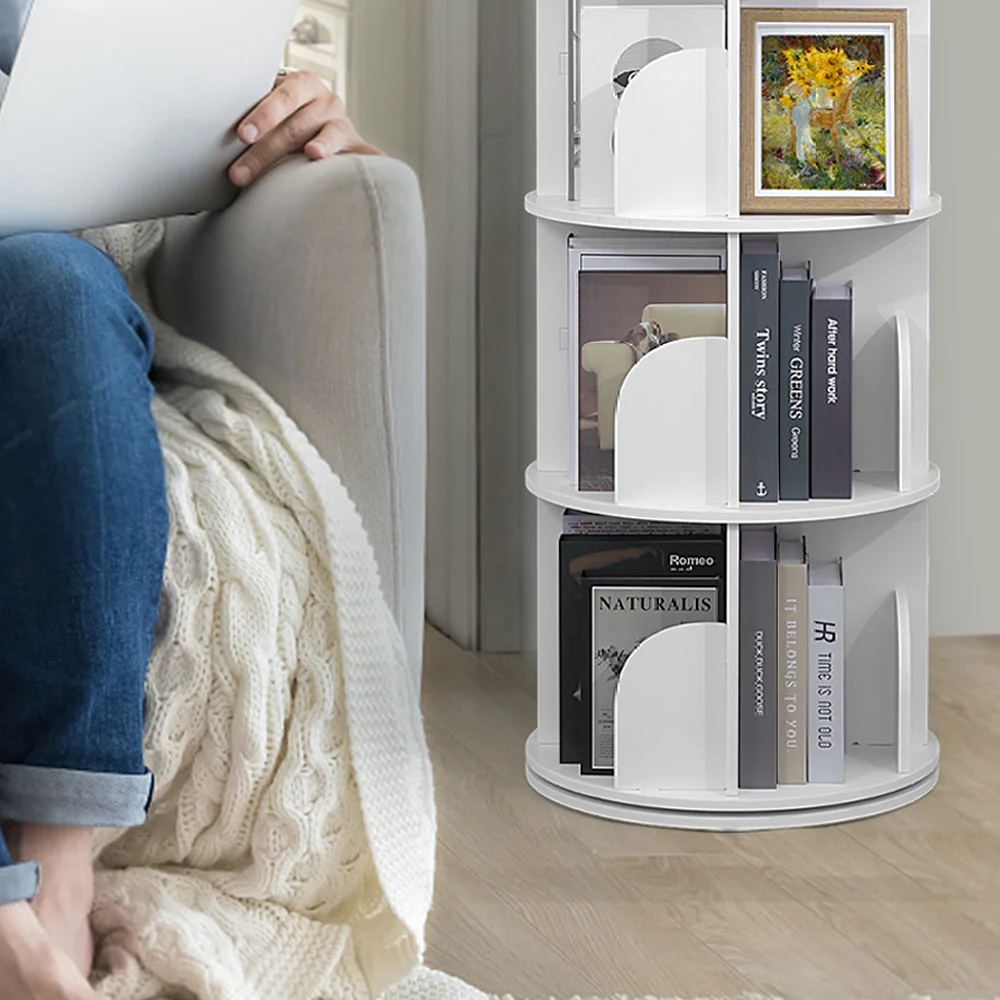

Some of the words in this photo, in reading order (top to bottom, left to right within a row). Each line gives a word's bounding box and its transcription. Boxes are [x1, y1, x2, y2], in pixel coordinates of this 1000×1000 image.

[827, 318, 839, 345] After
[757, 328, 770, 376] Twins
[828, 348, 838, 374] hard
[751, 380, 770, 420] story
[790, 357, 804, 420] GREENS
[827, 377, 838, 404] work
[670, 555, 714, 565] Romeo
[600, 597, 711, 611] NATURALIS
[785, 598, 796, 614] IT
[784, 620, 796, 689] BELONGS
[784, 696, 796, 714] TO
